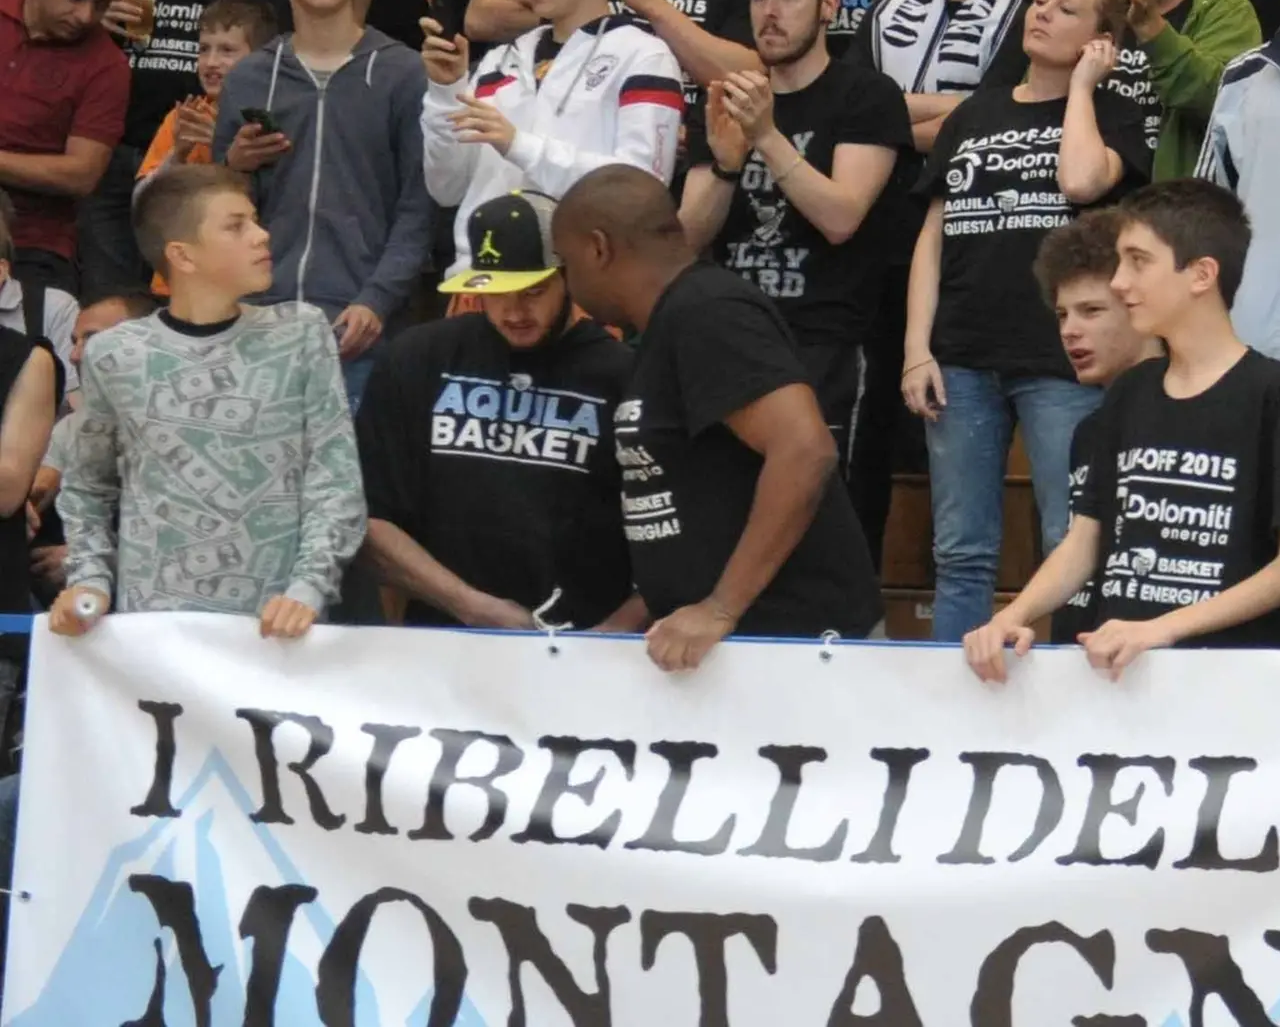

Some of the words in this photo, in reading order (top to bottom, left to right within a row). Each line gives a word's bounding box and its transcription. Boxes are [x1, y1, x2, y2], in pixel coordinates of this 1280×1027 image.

[943, 196, 995, 214] AQUILA
[1020, 191, 1067, 208] BASKE
[944, 219, 994, 236] QUESTA
[433, 381, 600, 436] AQUILA
[431, 415, 598, 465] BASKET
[1180, 451, 1237, 481] 2015
[1125, 494, 1233, 531] Dolomiti
[1160, 527, 1229, 547] energia
[1157, 557, 1225, 578] BASKET
[129, 699, 184, 819] I
[234, 707, 930, 866] RIBELLI
